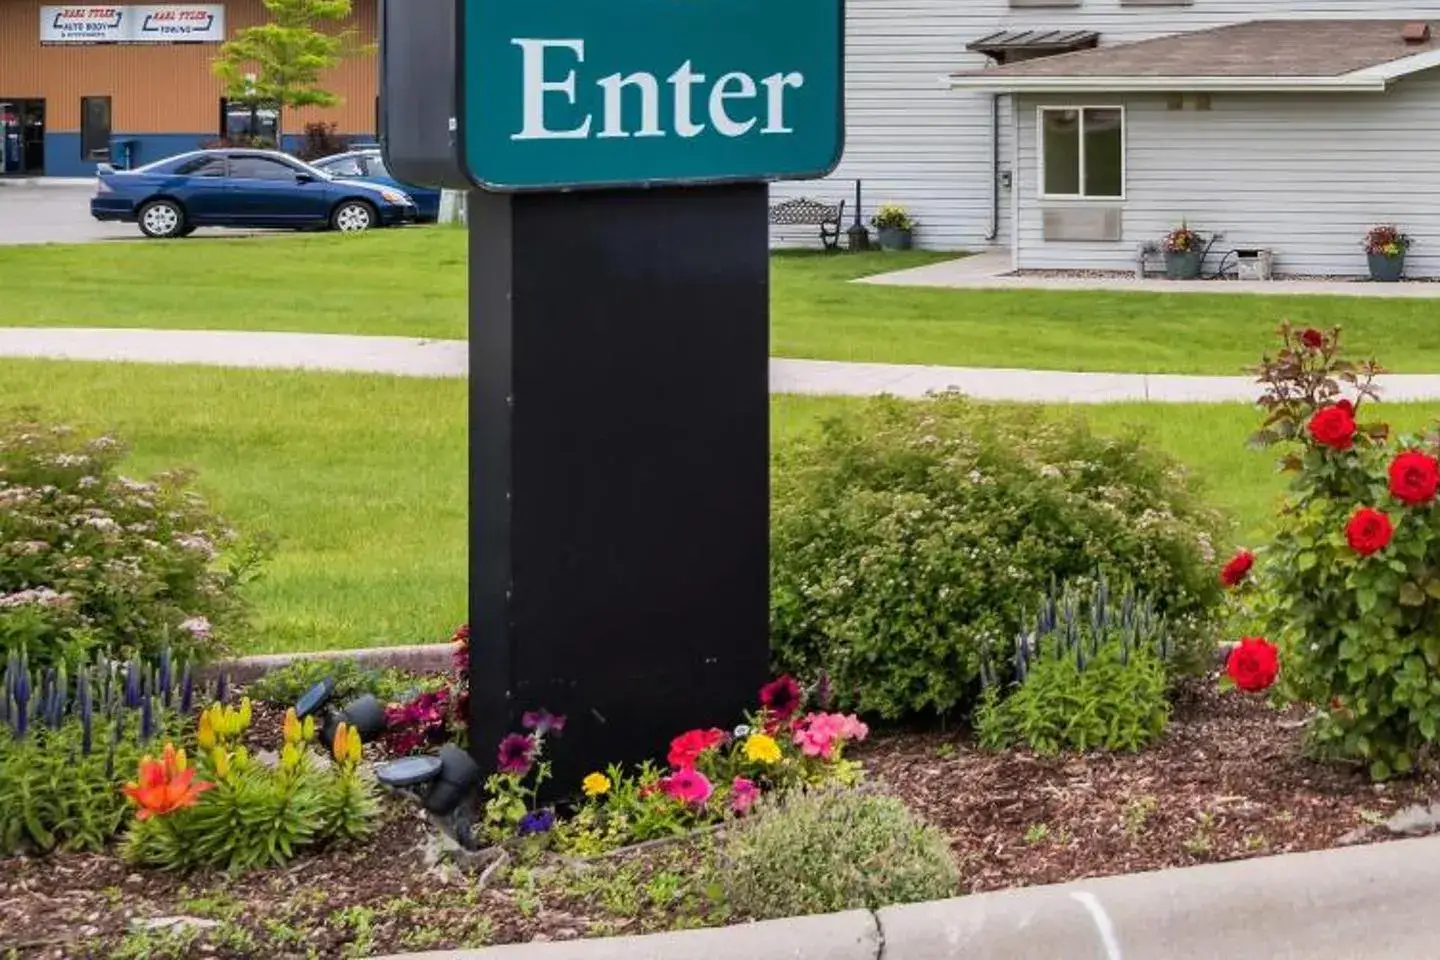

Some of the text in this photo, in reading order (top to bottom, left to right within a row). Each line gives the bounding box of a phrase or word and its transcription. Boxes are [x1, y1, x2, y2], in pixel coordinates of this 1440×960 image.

[63, 22, 108, 31] AUTO BODY
[510, 38, 804, 140] Enter
